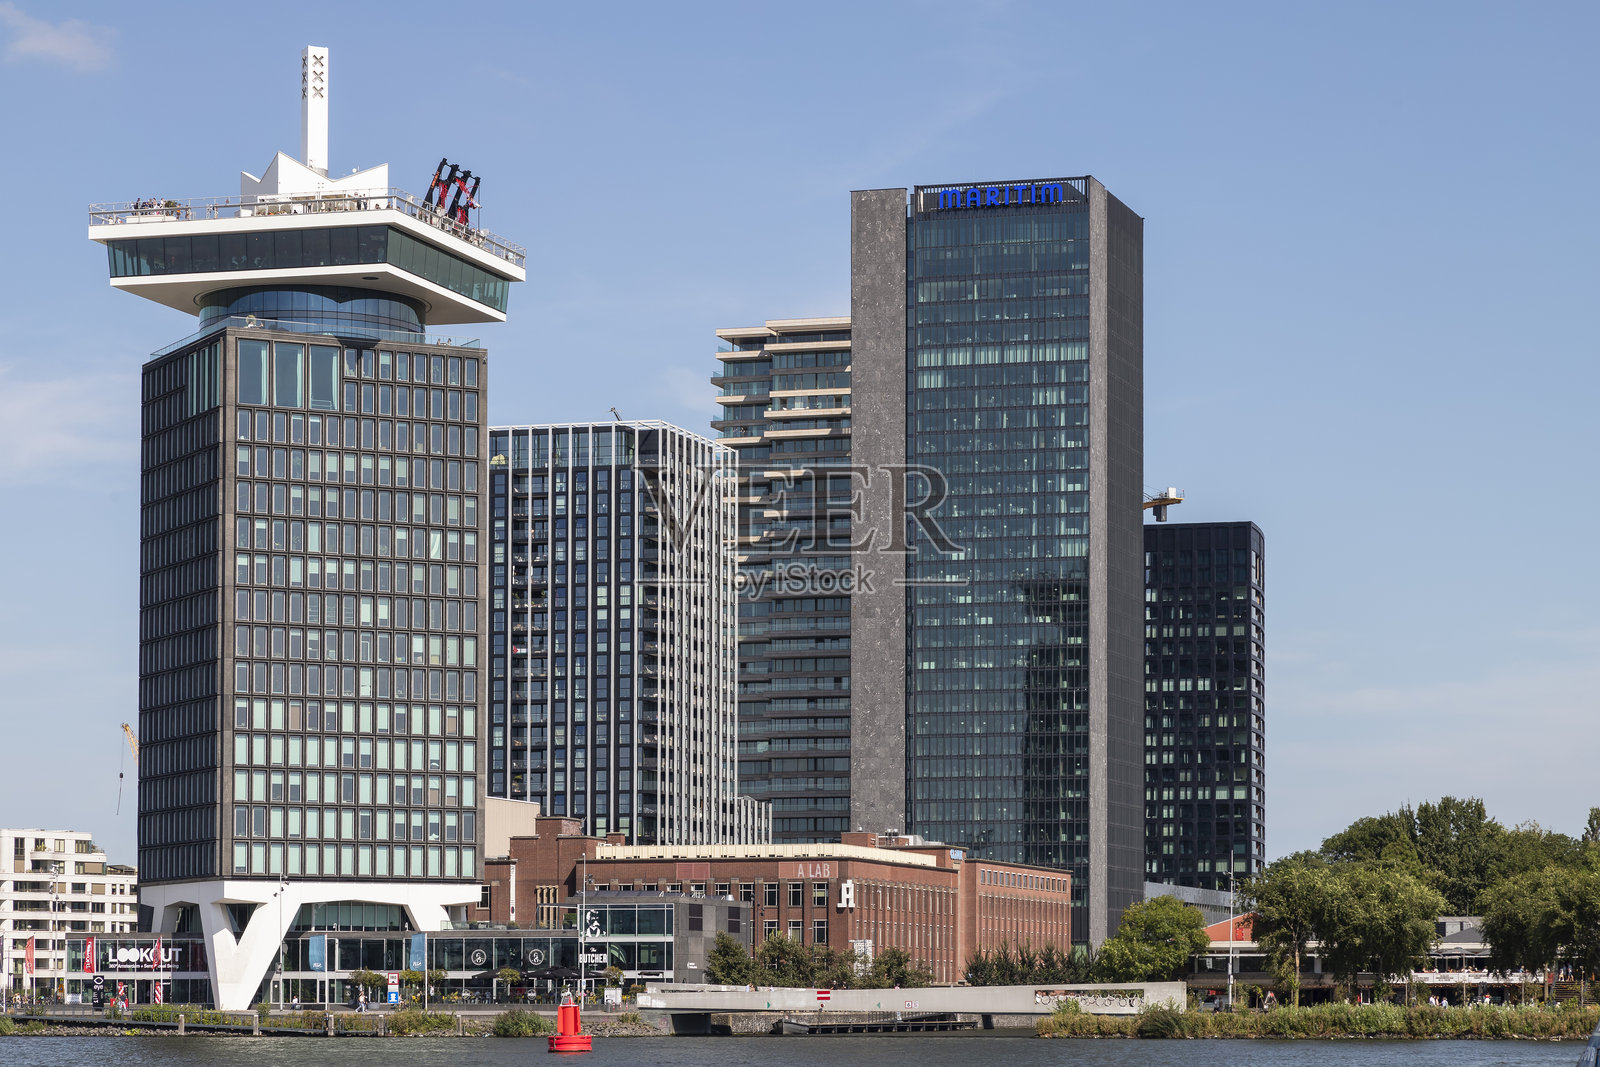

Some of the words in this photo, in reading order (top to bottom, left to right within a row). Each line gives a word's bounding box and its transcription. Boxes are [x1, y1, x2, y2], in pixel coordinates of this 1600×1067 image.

[939, 183, 1063, 208] MARITIM
[797, 863, 805, 878] A
[809, 863, 831, 878] LAB
